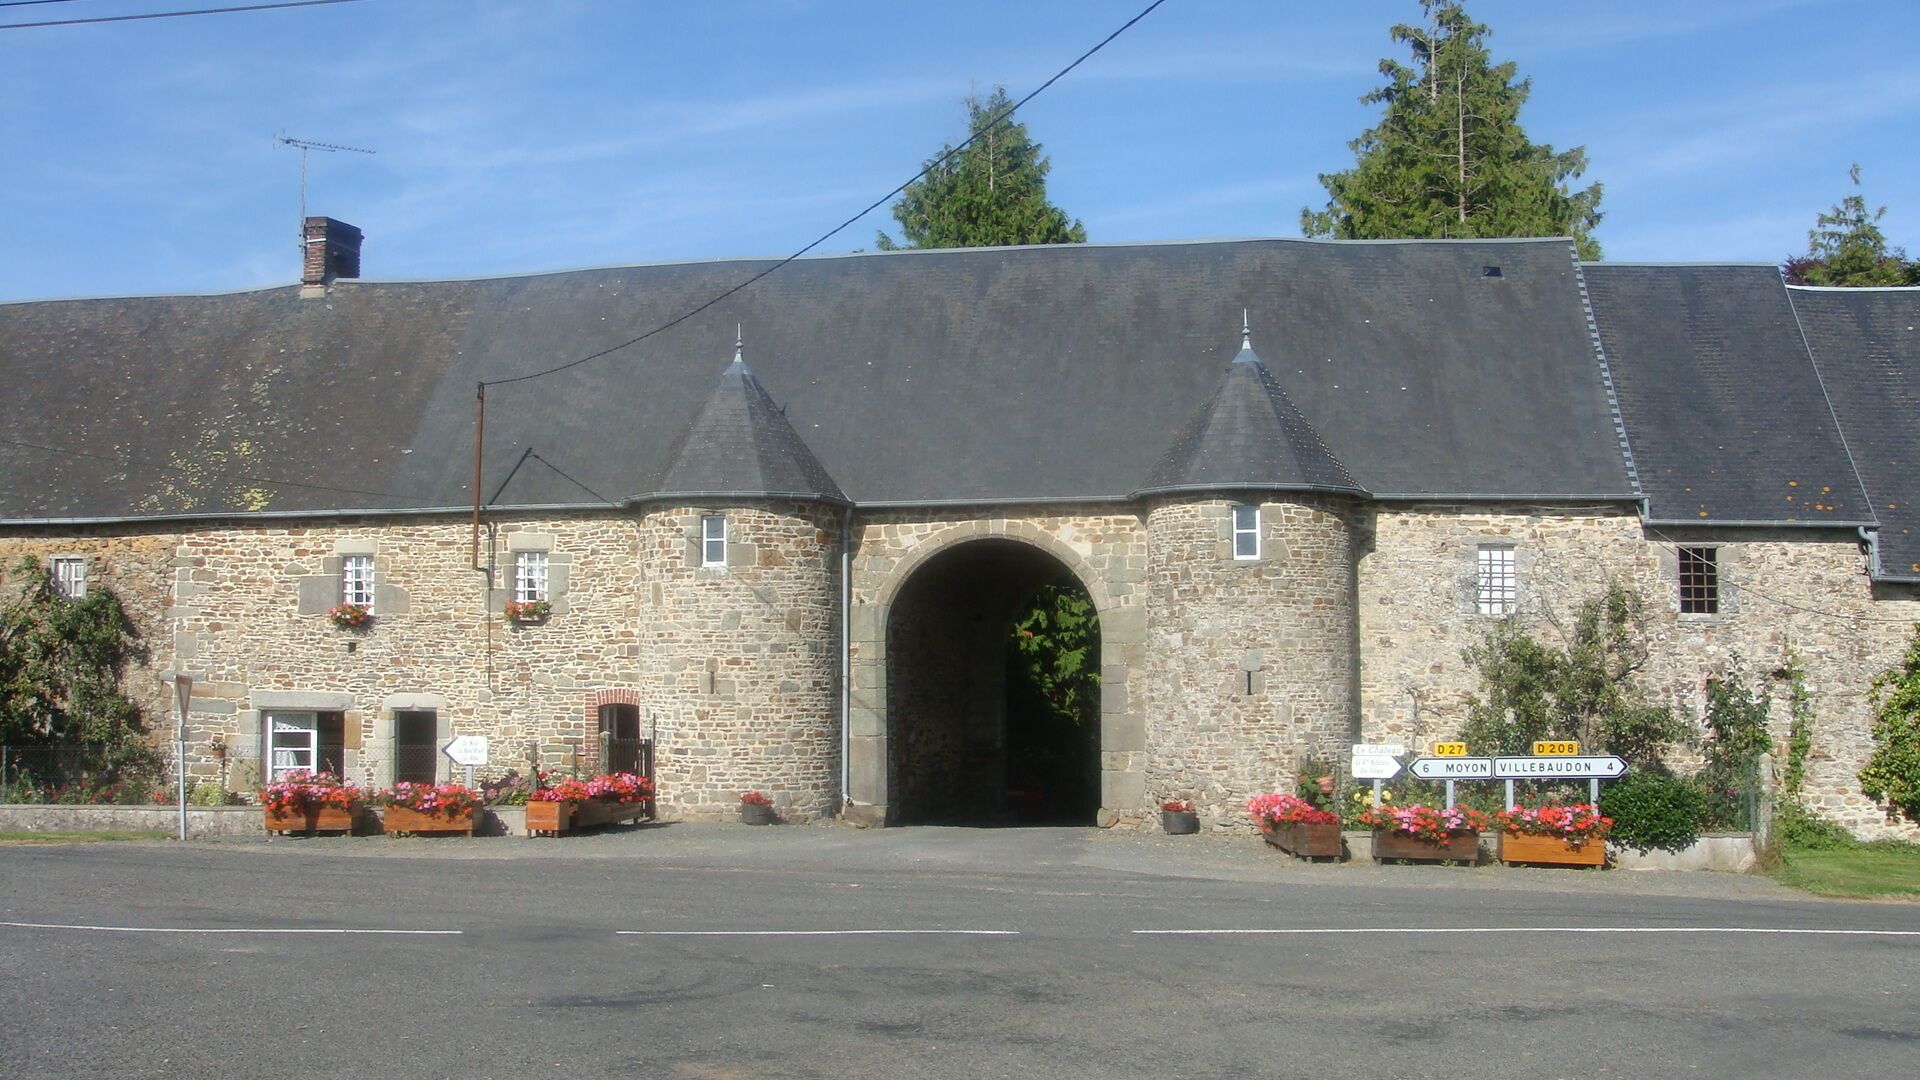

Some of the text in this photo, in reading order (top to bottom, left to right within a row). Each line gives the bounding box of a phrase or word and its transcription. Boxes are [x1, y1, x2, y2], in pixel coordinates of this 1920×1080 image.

[1437, 745, 1463, 755] D 27
[1537, 744, 1574, 754] D 208
[1422, 763, 1488, 773] 6 MOYON
[1499, 762, 1614, 772] VILLEBAUDON 4
